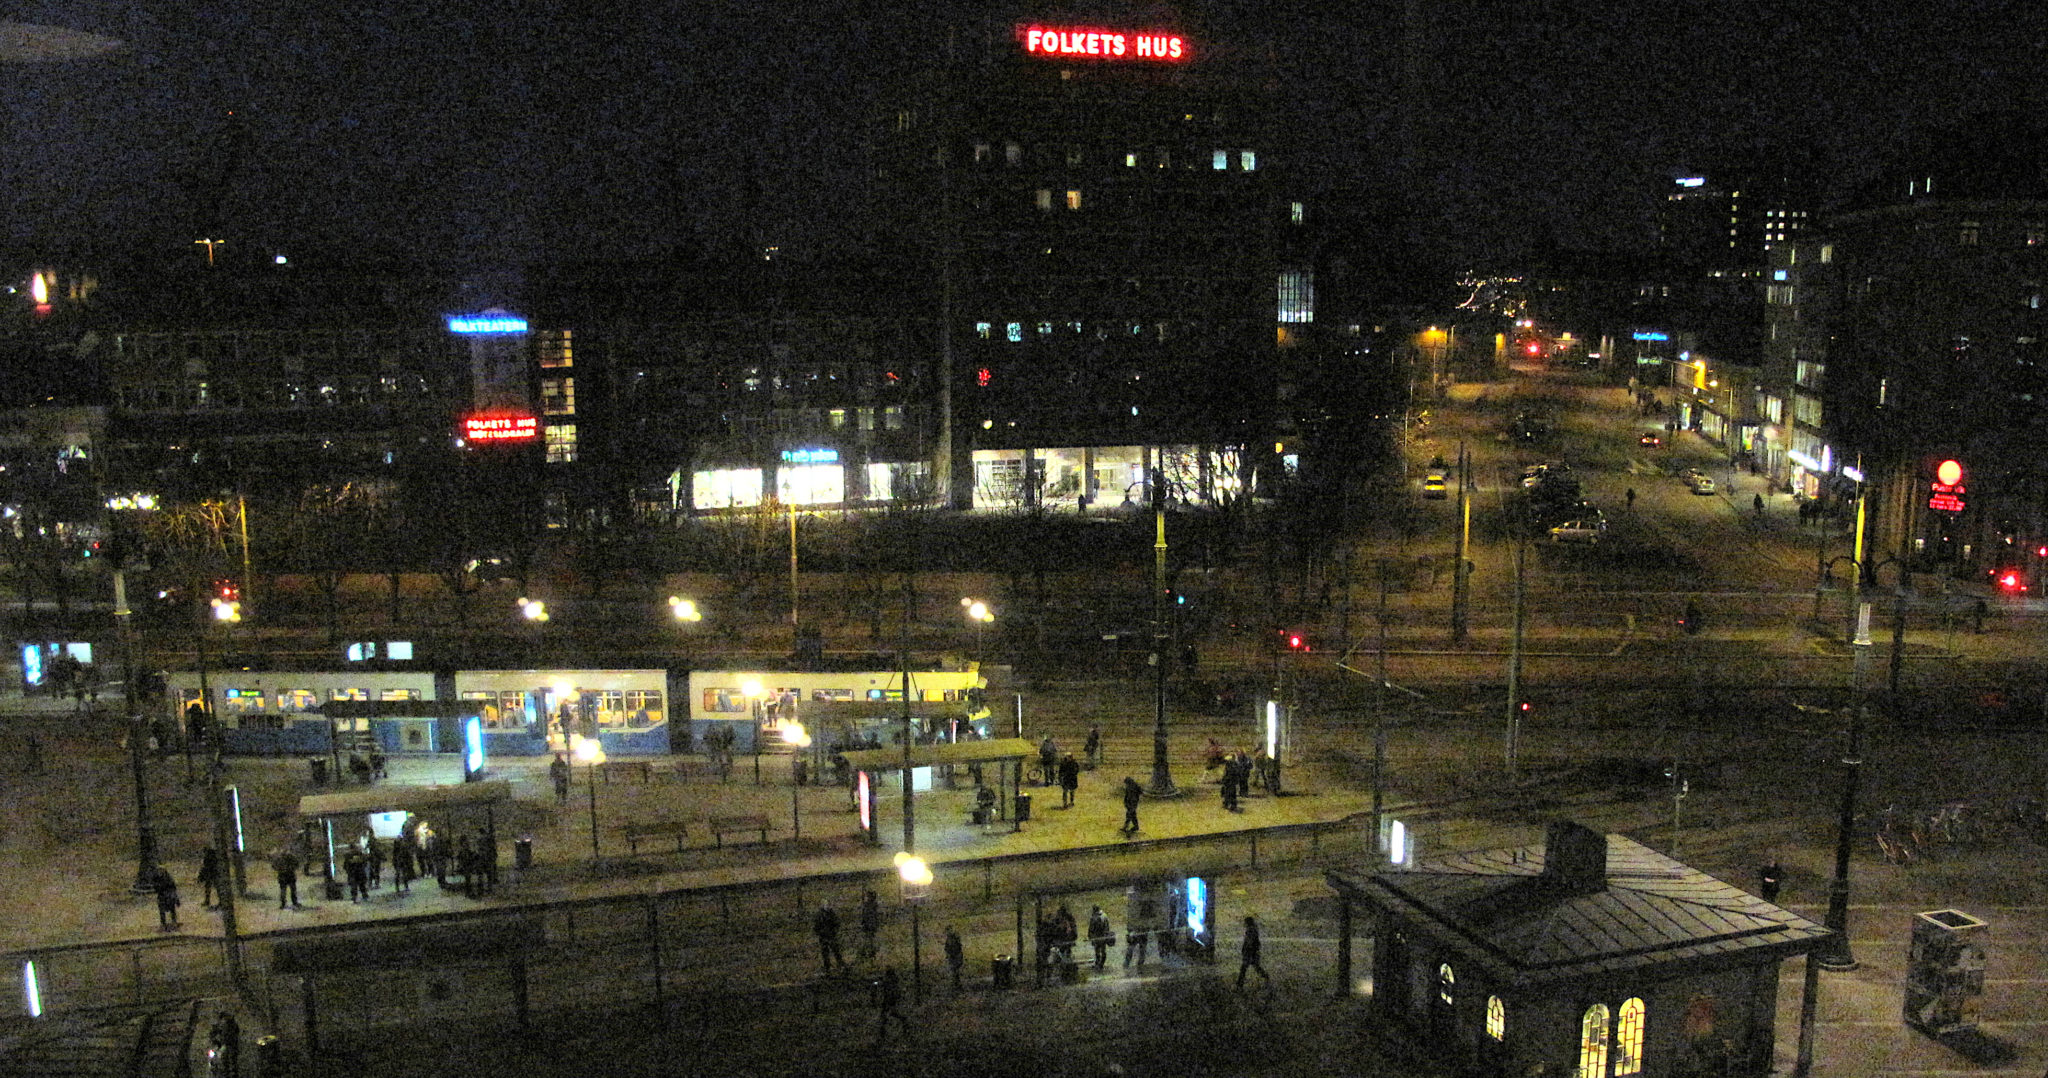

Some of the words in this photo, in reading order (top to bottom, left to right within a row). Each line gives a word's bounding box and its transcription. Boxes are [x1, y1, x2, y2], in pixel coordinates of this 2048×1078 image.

[1028, 30, 1125, 55] FOLKETS
[1137, 36, 1182, 58] HUS
[466, 419, 511, 429] FOLKETS
[517, 417, 537, 427] HUS
